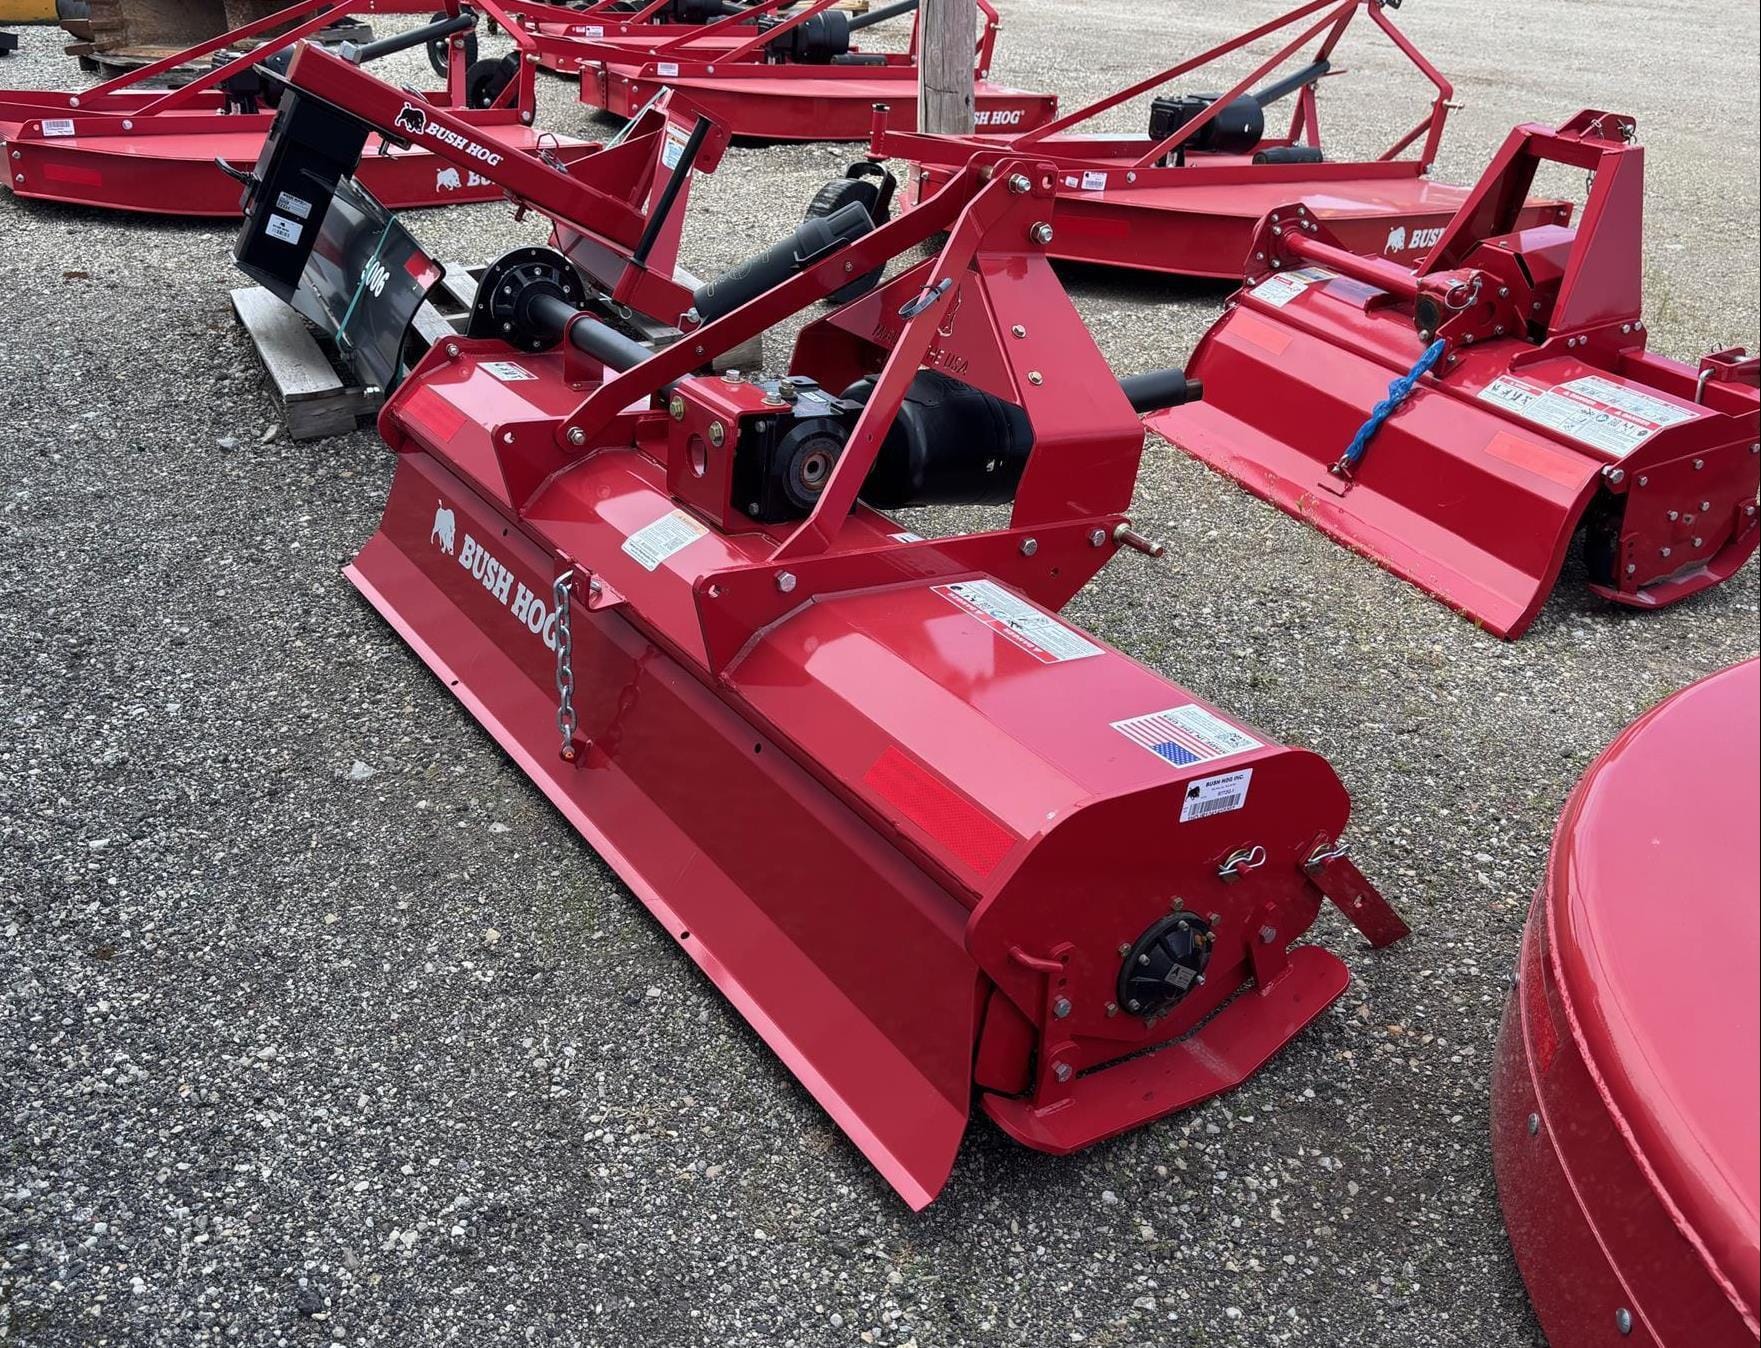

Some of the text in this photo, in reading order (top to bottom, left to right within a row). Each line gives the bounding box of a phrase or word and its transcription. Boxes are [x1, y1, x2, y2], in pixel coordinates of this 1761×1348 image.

[974, 110, 1021, 125] SH HOG
[425, 122, 501, 167] BUSH HOG
[944, 352, 969, 376] USA
[458, 533, 558, 652] BUSH HOG
